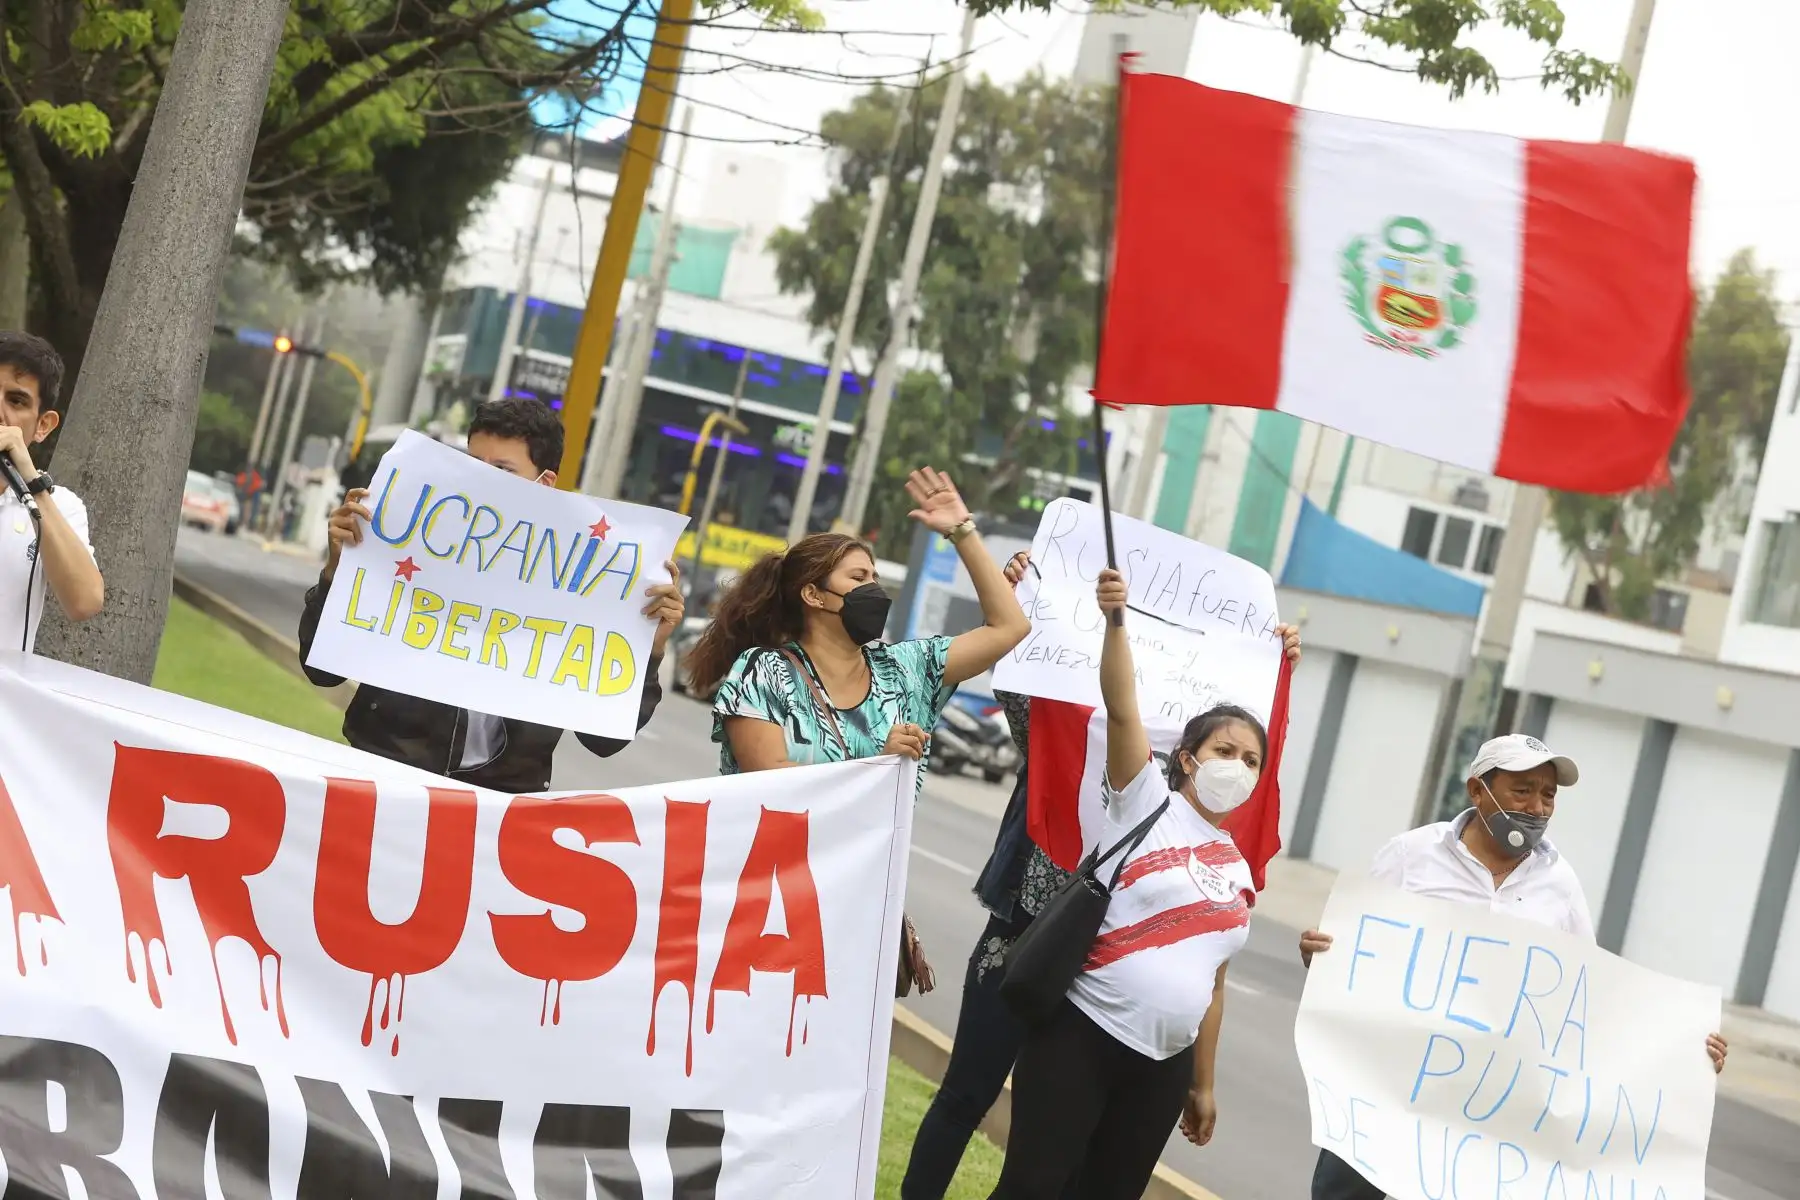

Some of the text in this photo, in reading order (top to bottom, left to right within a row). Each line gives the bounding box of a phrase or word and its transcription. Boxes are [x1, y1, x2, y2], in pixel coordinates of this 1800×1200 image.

[1013, 630, 1143, 686] VENEZUA
[107, 739, 829, 1078] RUSIA
[1347, 913, 1588, 1071] FUERA
[1313, 1076, 1378, 1175] DE
[1410, 1034, 1662, 1166] PUTIN
